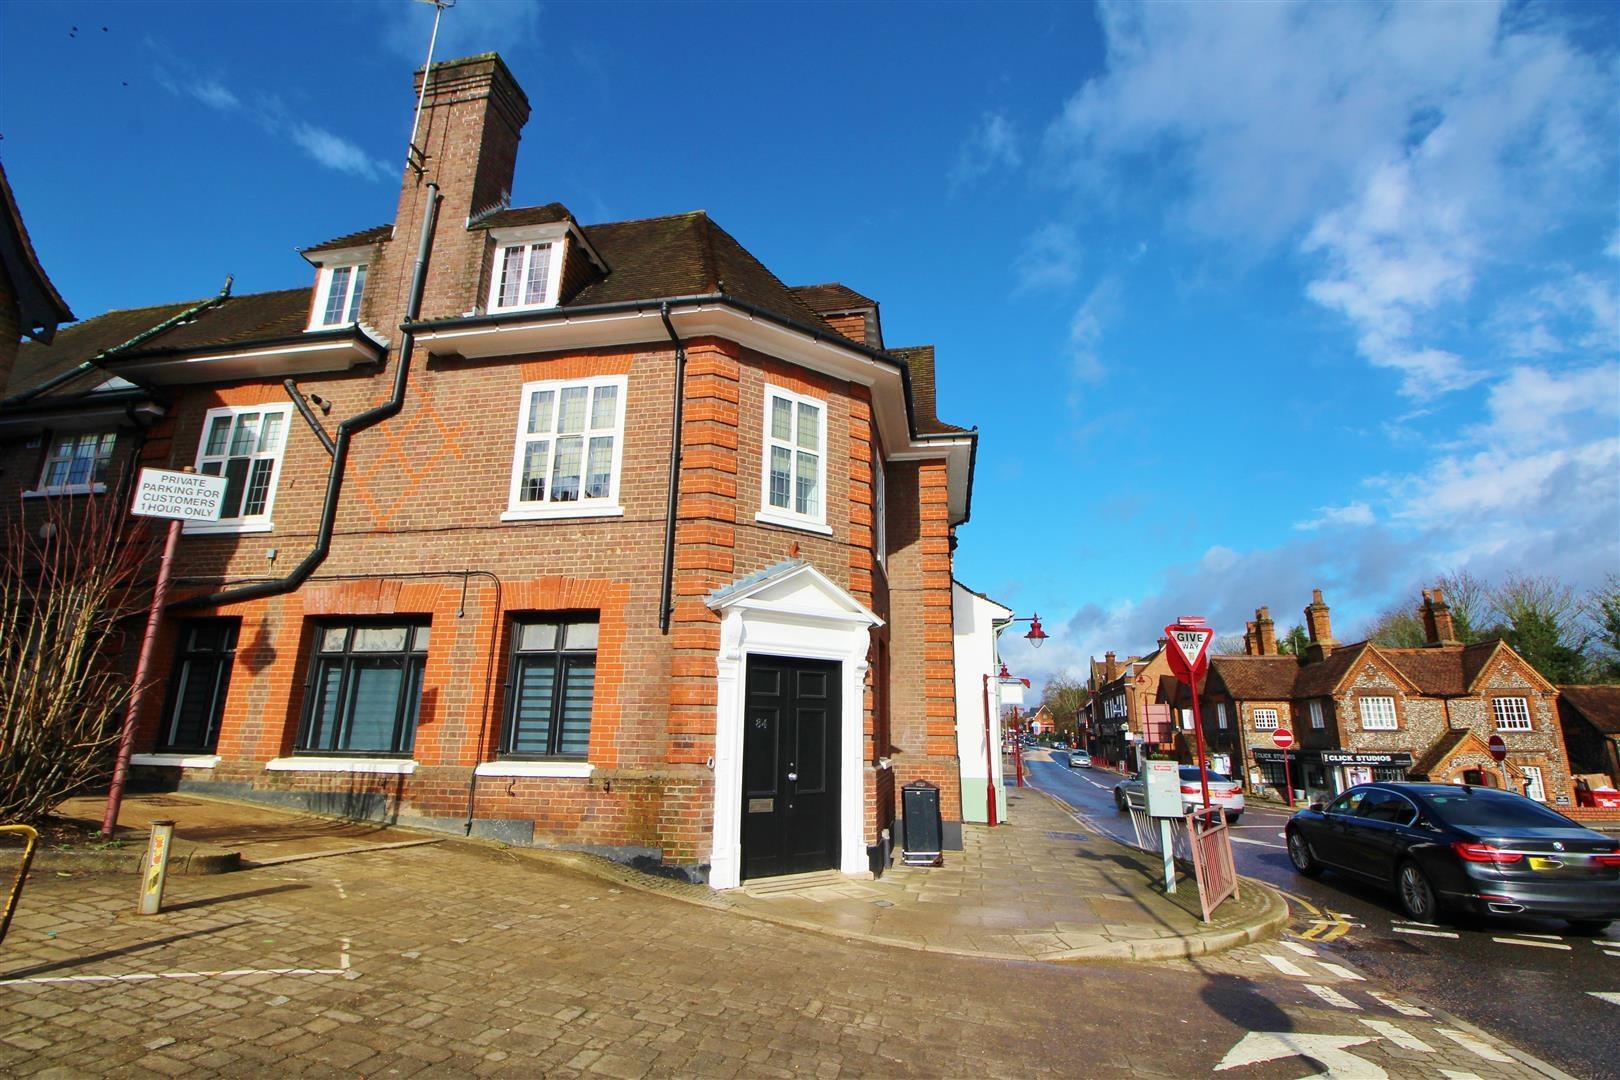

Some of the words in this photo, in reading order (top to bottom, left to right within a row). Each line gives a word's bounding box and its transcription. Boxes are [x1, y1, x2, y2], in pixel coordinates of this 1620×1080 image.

[161, 475, 206, 487] PRIVATE
[142, 483, 193, 495] PARKING
[196, 489, 220, 499] FOR
[142, 493, 215, 507] CUSTOMERS
[147, 504, 181, 514] HOUR
[184, 507, 213, 517] ONLY
[1177, 632, 1204, 643] GIVE
[1328, 754, 1354, 762] CLICK
